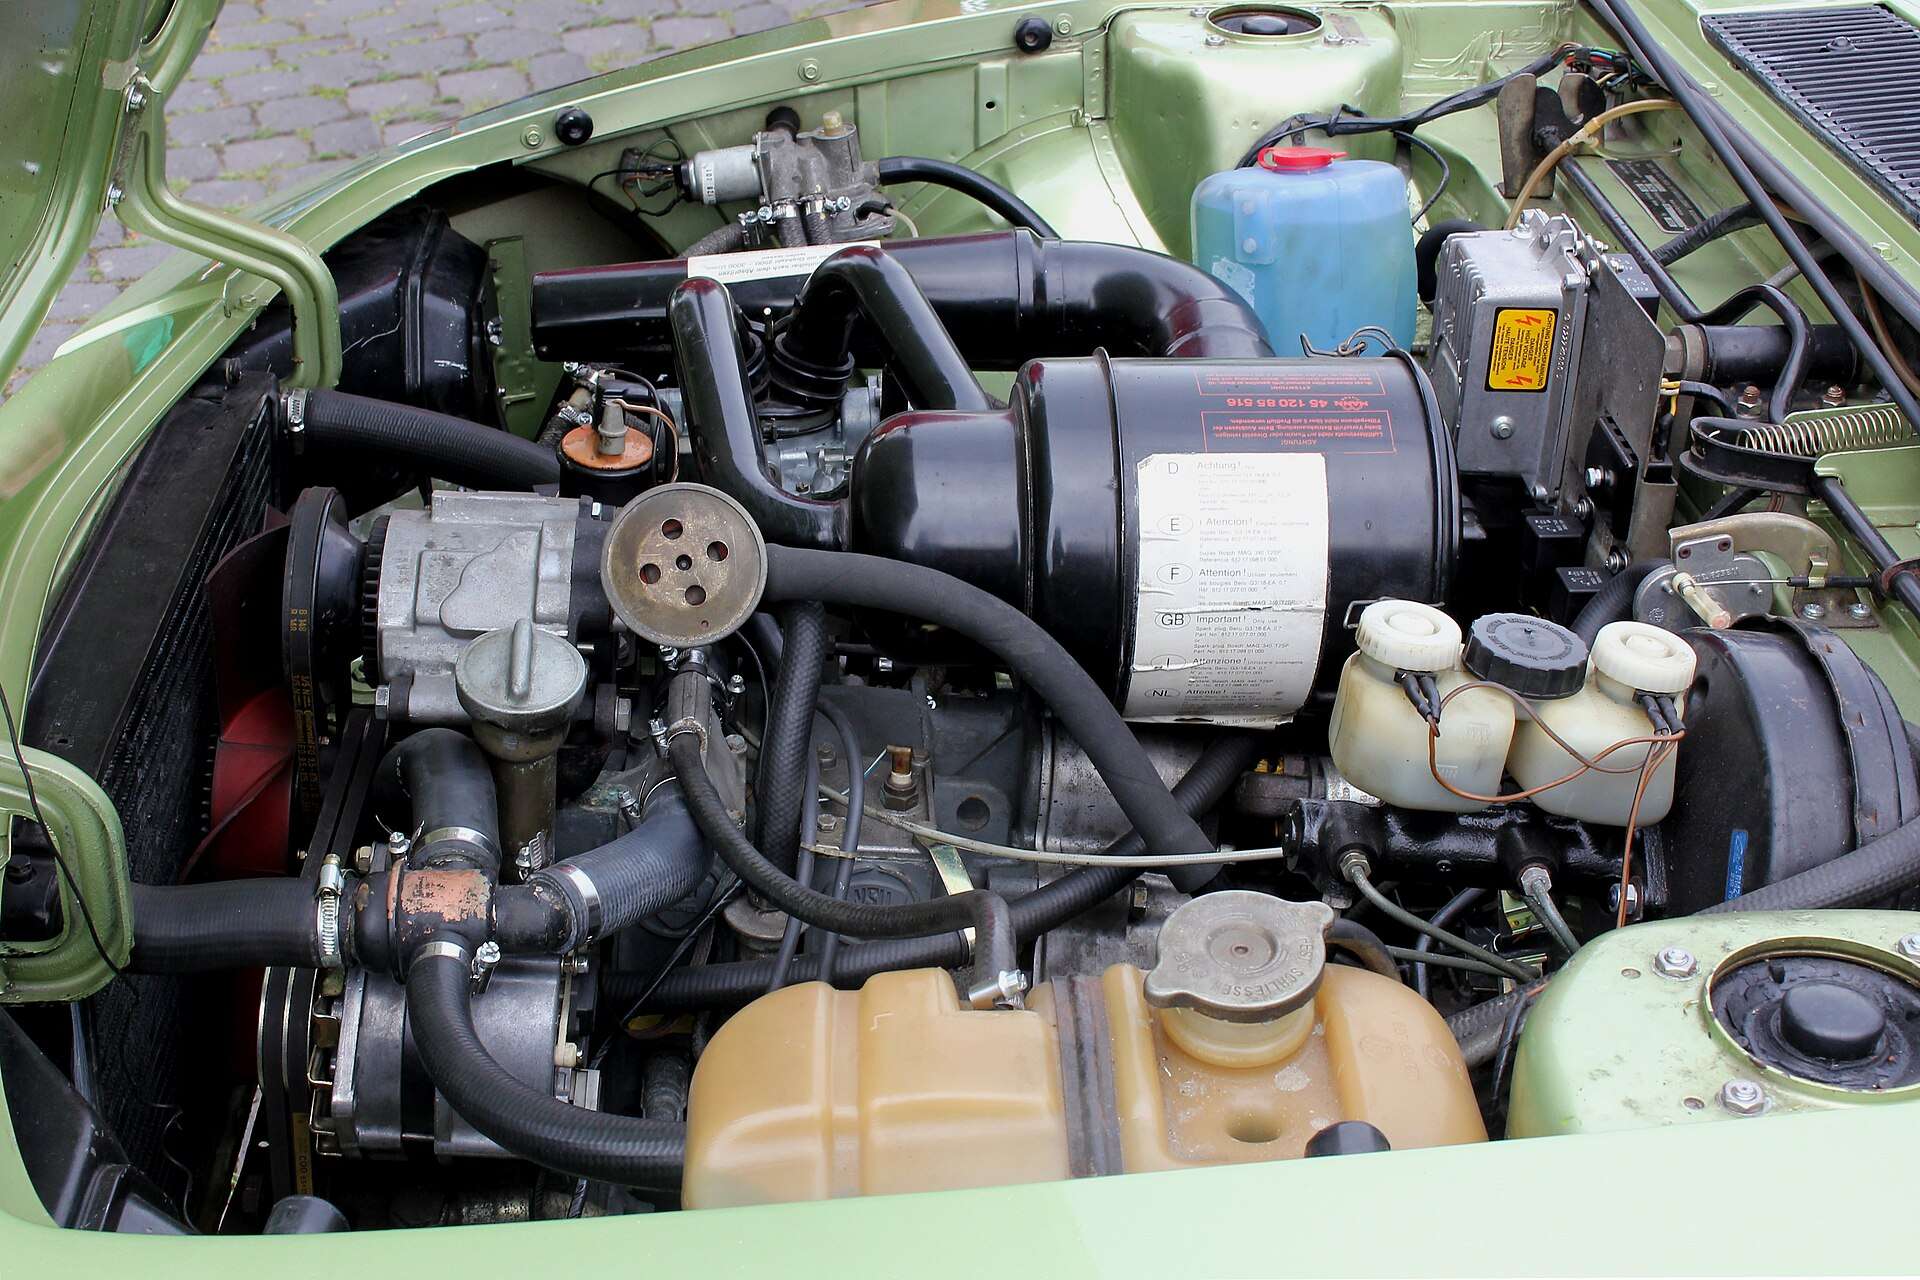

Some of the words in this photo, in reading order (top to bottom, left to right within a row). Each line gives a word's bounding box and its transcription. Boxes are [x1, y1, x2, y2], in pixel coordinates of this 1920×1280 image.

[1544, 313, 1553, 340] ACHTUNG
[1508, 337, 1516, 361] DANGER
[1500, 345, 1509, 370] TENSION
[1521, 345, 1529, 369] VOLTAGE
[1537, 340, 1549, 387] HOCHSPANNUNG
[1226, 398, 1253, 407] 516
[1256, 399, 1276, 408] 85
[1279, 399, 1306, 408] 120
[1167, 461, 1179, 475] D
[1170, 517, 1180, 531] E
[1170, 567, 1180, 581] F
[1161, 613, 1185, 626] GB
[1212, 967, 1304, 997] SCHLIESSEN
